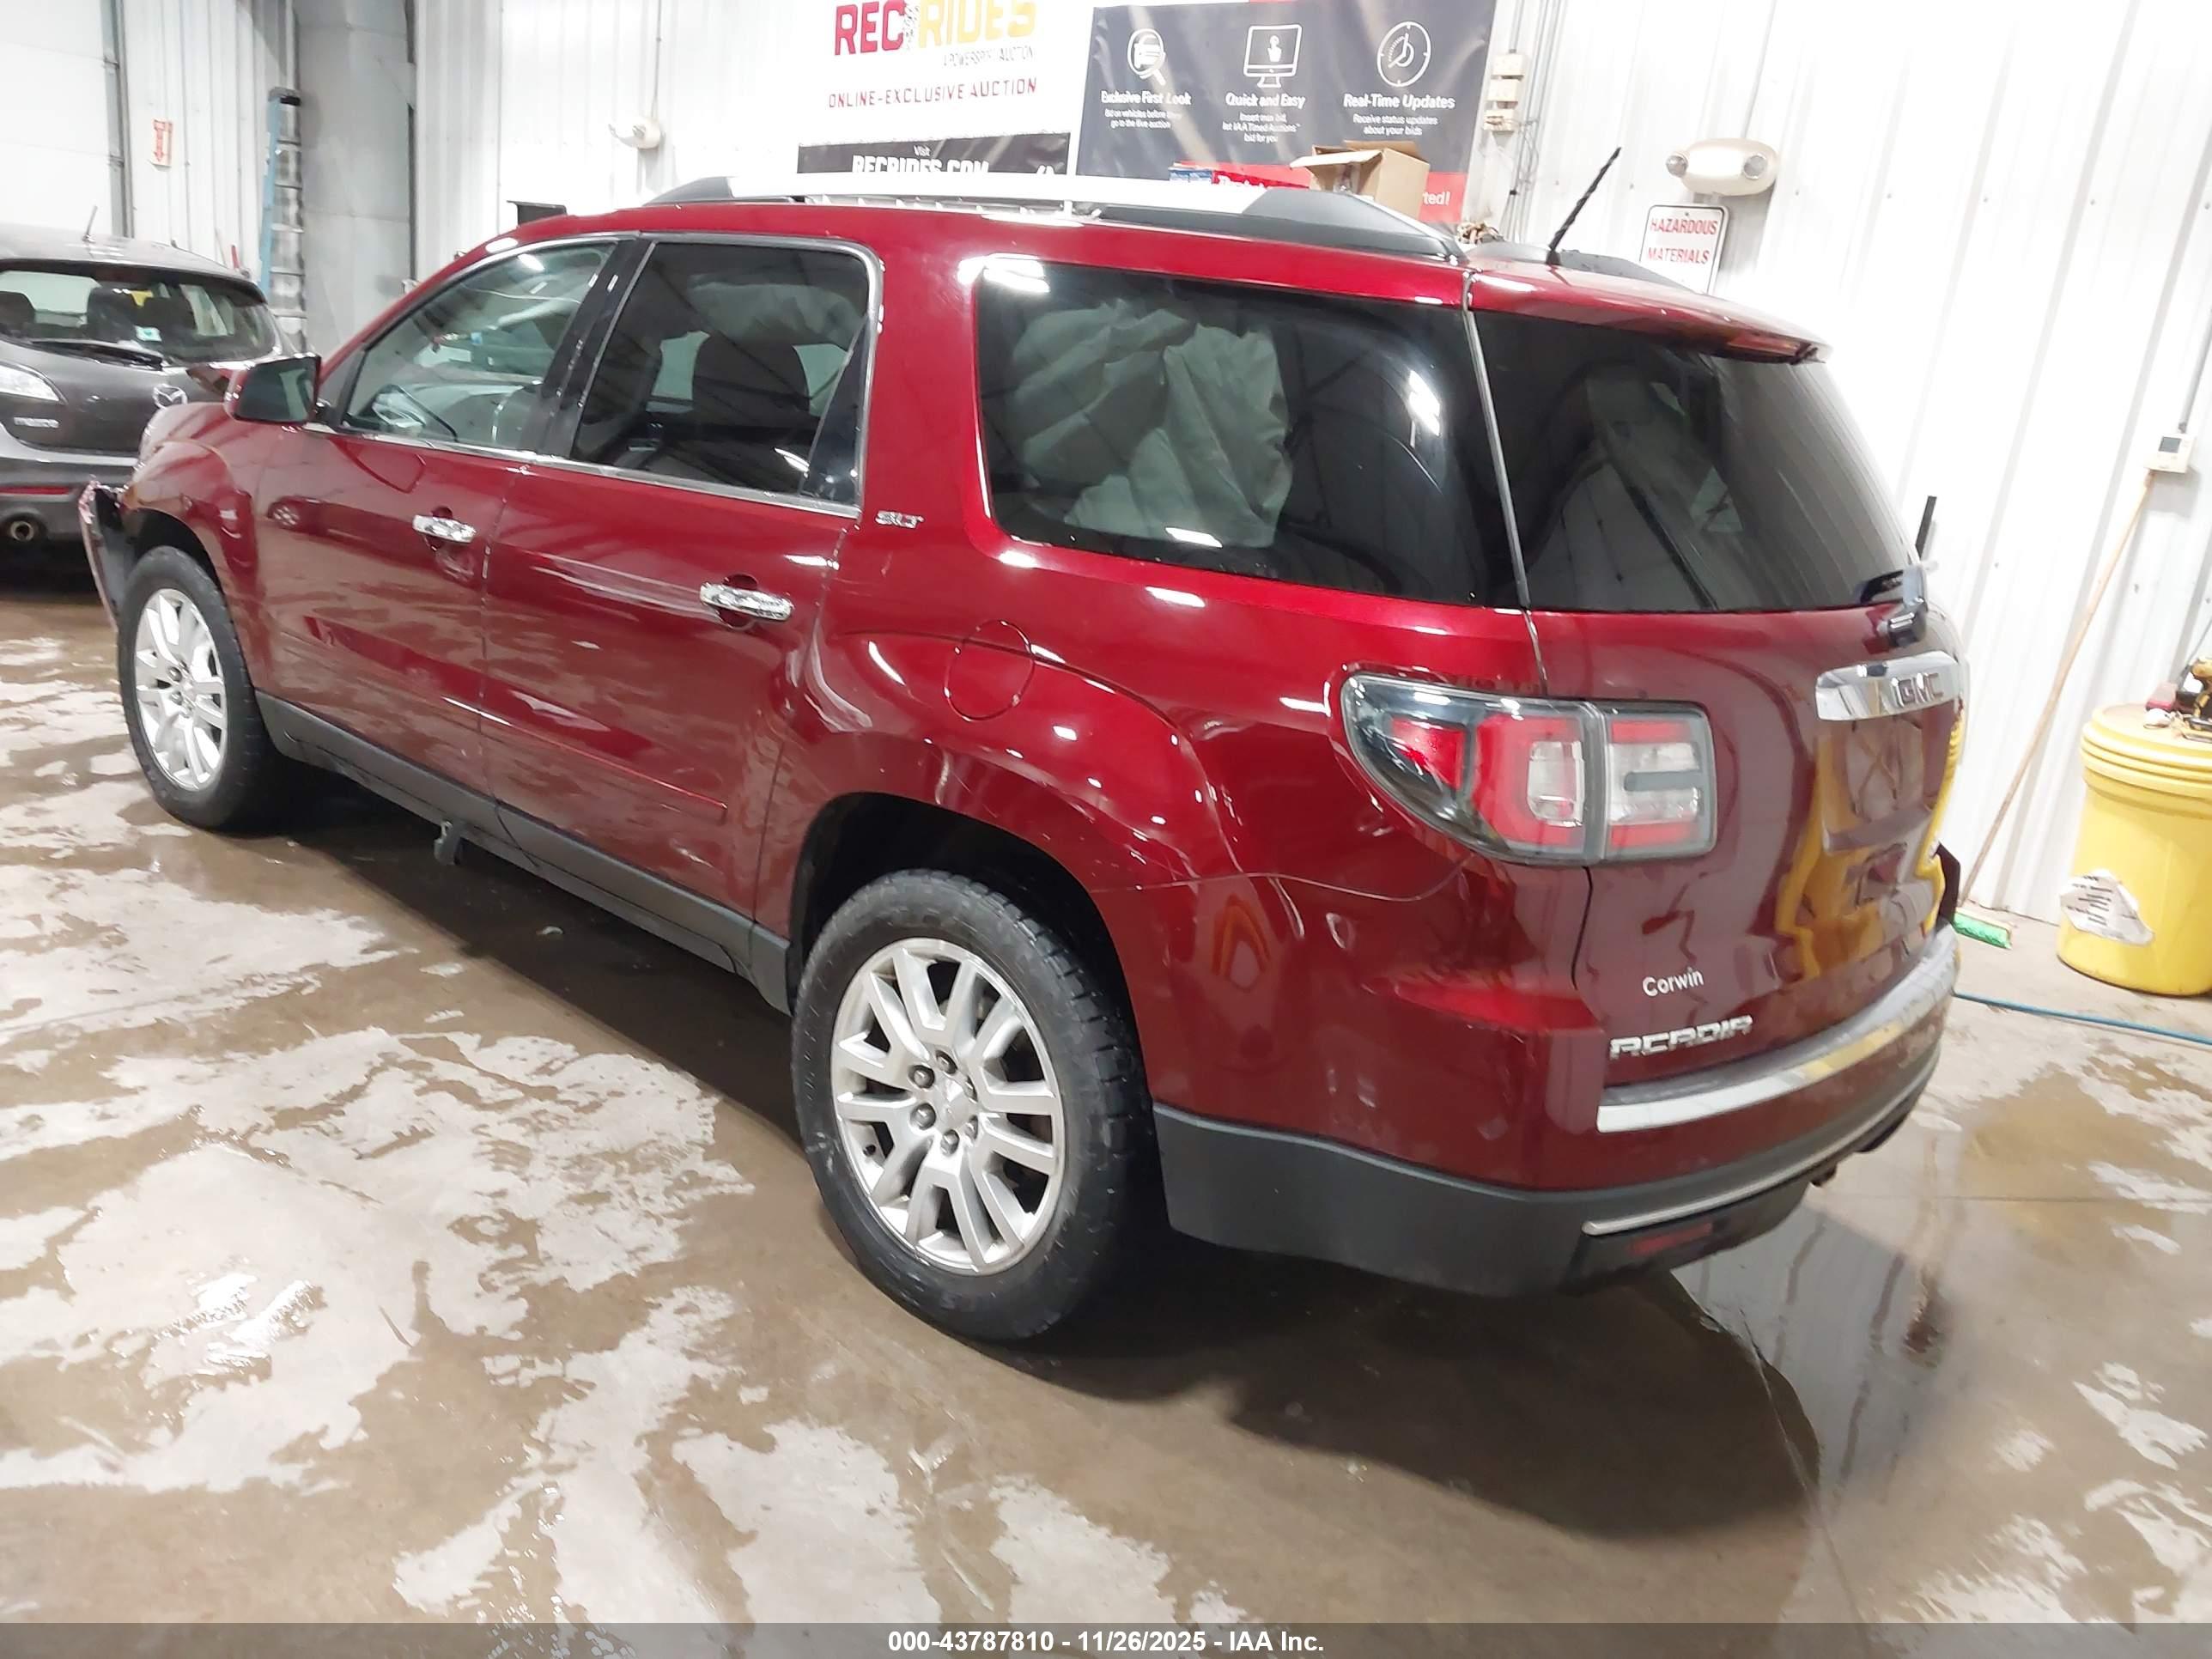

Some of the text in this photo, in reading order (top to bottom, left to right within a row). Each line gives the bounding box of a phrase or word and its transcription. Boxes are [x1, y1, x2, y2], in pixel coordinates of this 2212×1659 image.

[835, 0, 1036, 56] REC RIDES
[829, 77, 1037, 108] ONLINE-EXCLUSIVE AUCTION
[1167, 92, 1192, 105] Look
[1225, 92, 1305, 109] Quick and Easy
[1343, 93, 1455, 111] Real-Time Updates
[852, 155, 989, 173] RECRIDESCOM
[1422, 191, 1450, 206] ted!
[1650, 218, 1718, 235] HAZARDOUS
[1648, 246, 1711, 264] MATERIALS
[875, 510, 925, 529] SLT
[1894, 672, 1943, 706] GMC
[1642, 966, 1705, 997] Corwin
[1609, 1015, 1753, 1061] ACADIA
